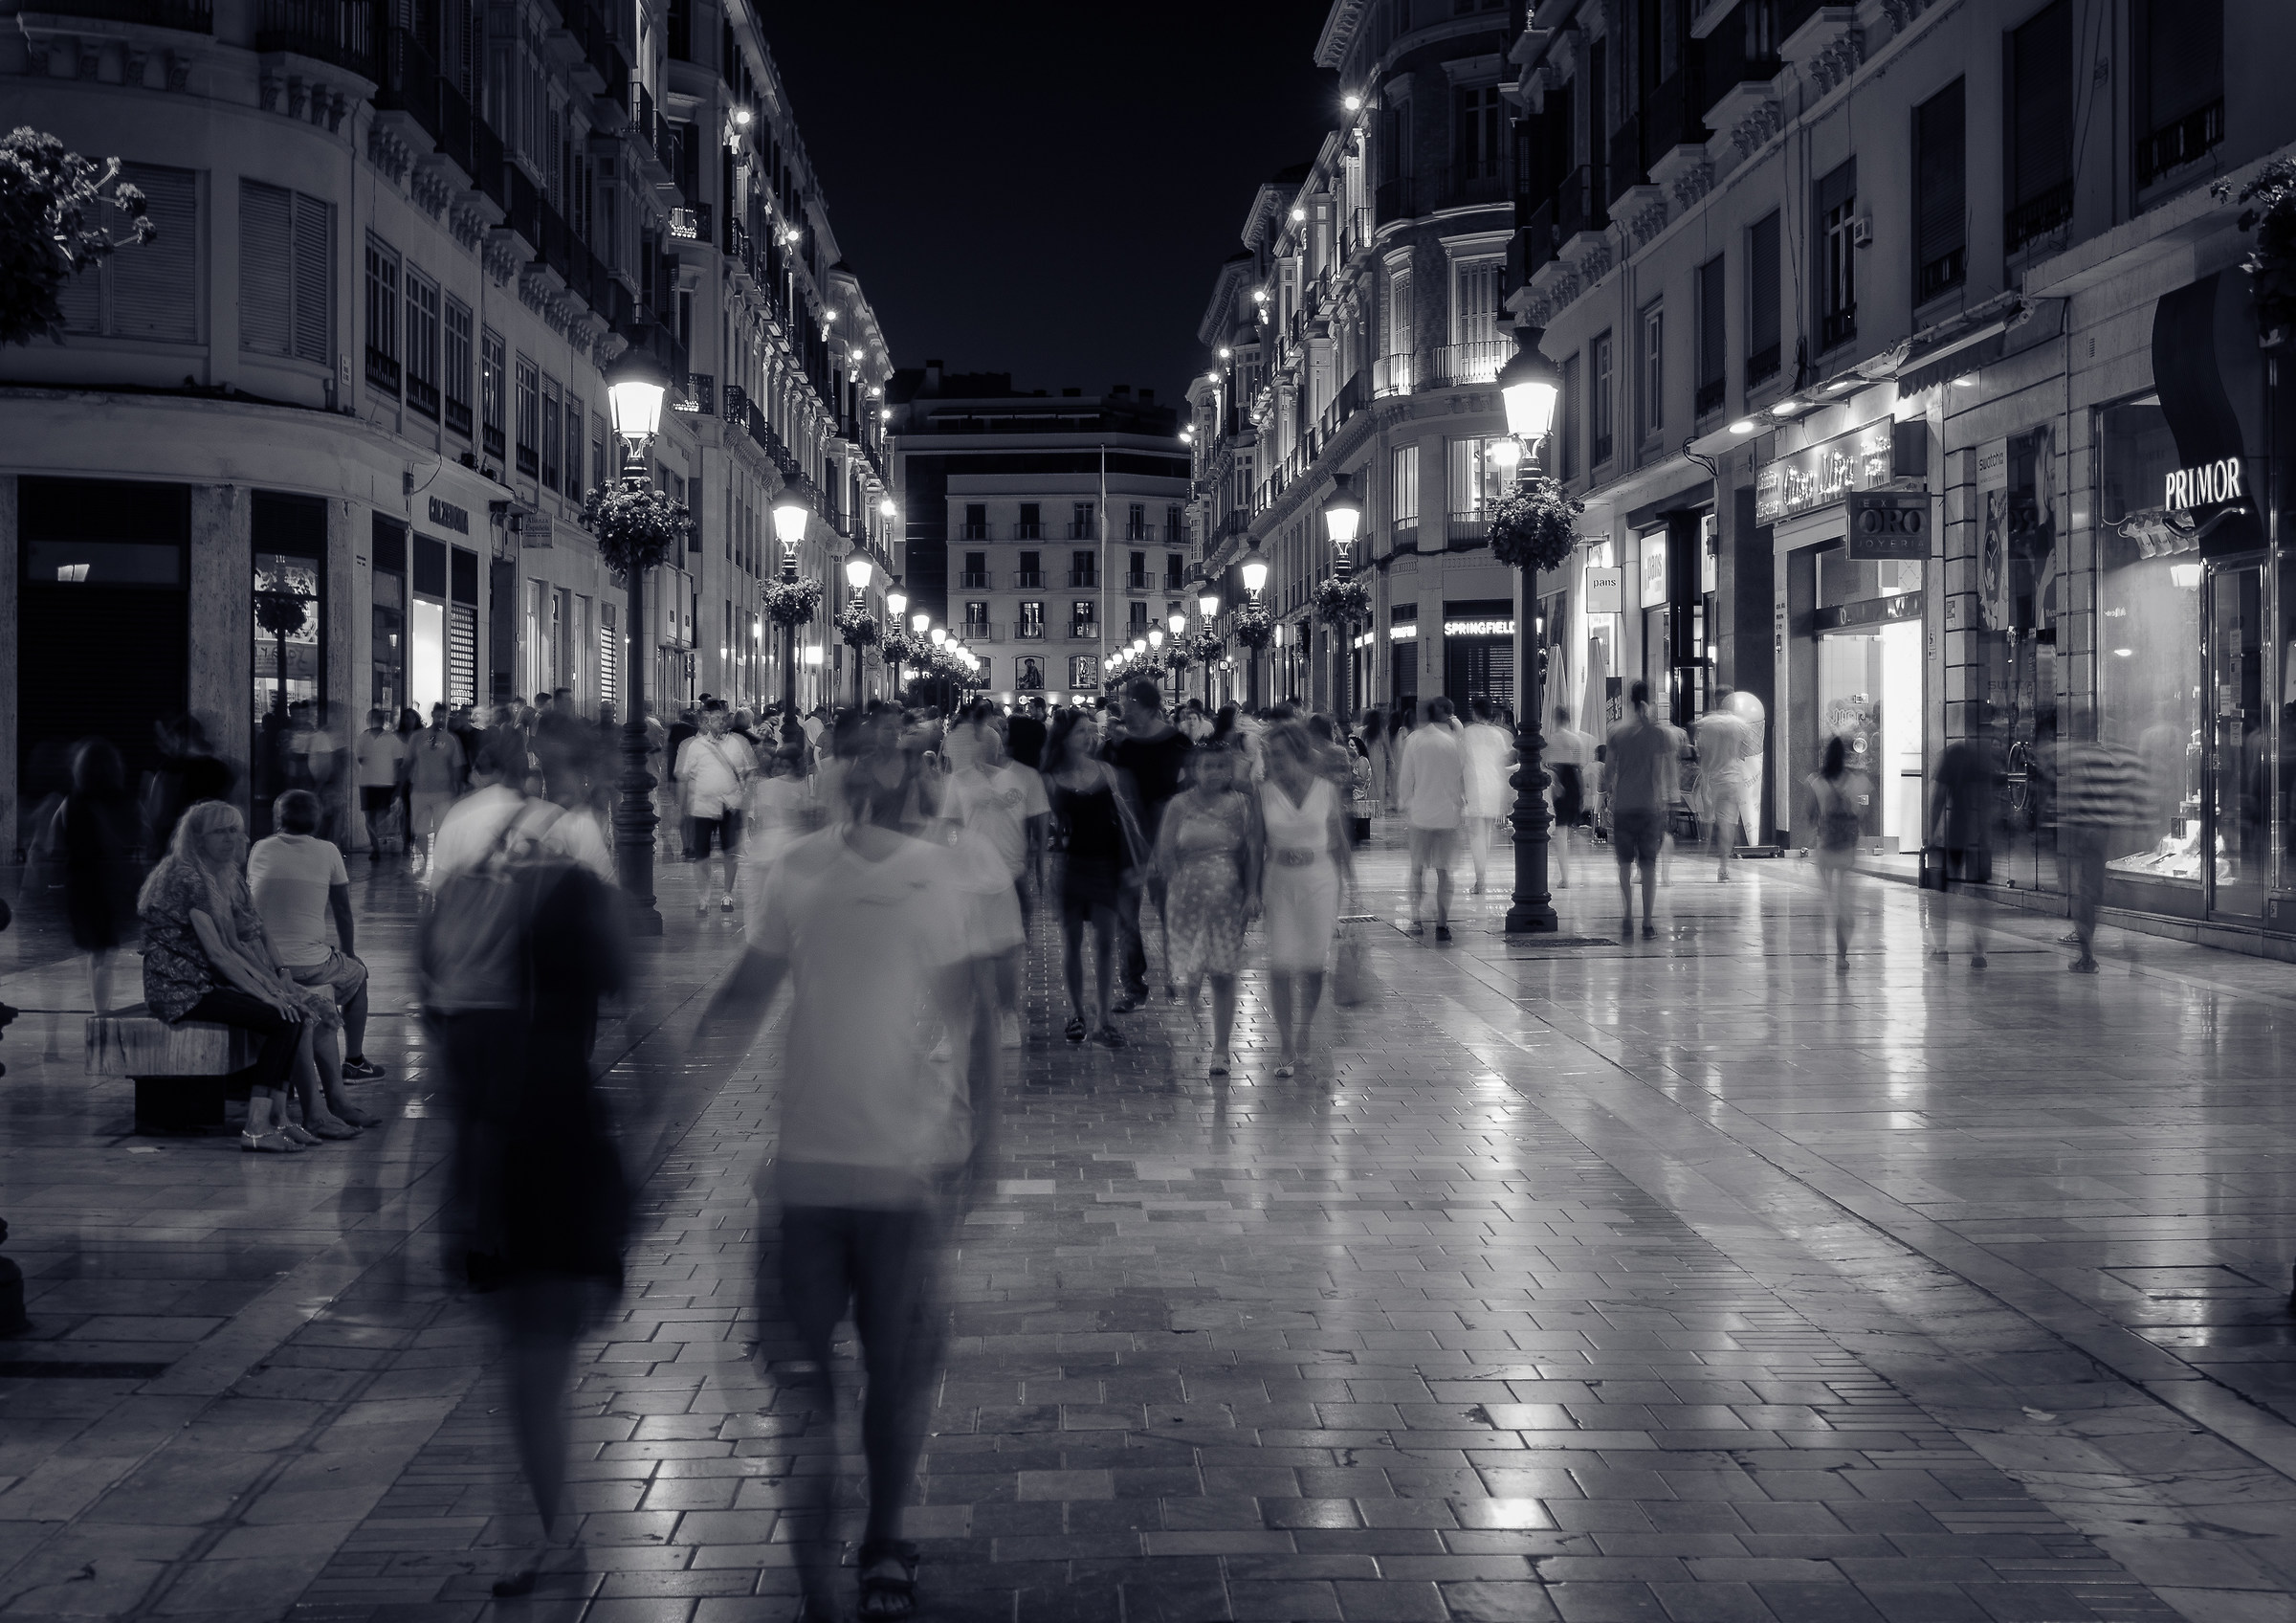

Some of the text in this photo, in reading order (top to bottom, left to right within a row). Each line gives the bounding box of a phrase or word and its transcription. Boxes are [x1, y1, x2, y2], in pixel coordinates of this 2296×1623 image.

[2165, 456, 2242, 512] PRIMOR
[1858, 509, 1928, 535] ORO
[1593, 578, 1617, 589] pans
[1445, 621, 1515, 635] SPRINGFIELD
